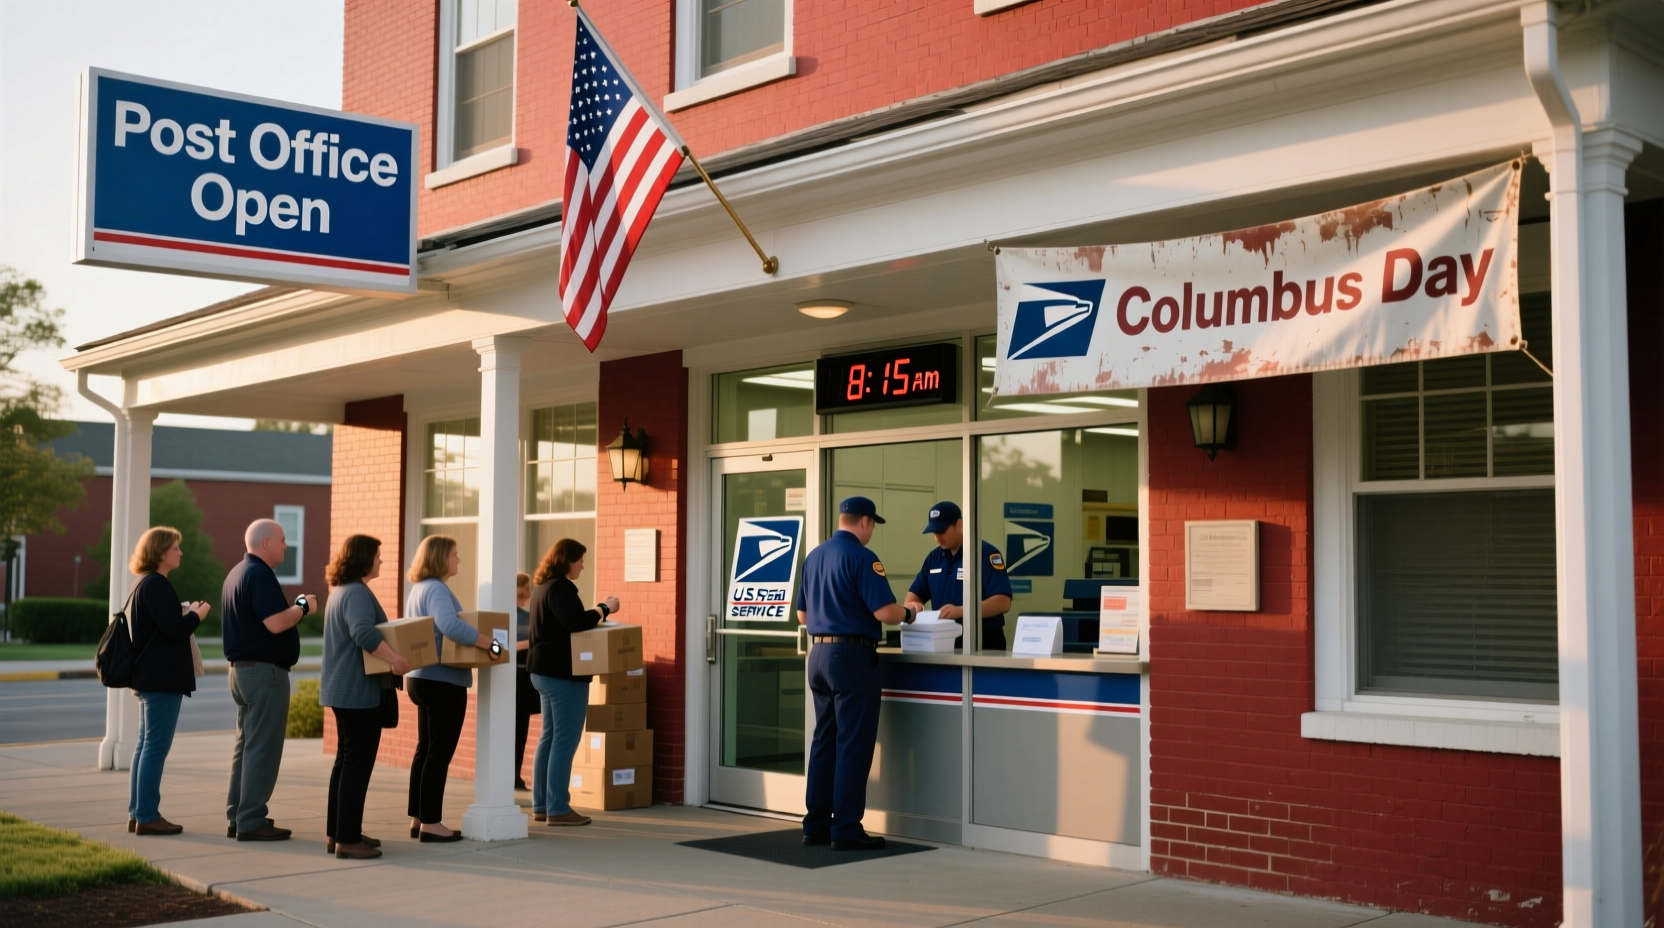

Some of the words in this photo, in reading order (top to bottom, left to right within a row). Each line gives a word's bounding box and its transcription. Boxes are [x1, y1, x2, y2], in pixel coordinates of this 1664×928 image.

[114, 100, 236, 164] Post
[249, 122, 398, 187] Office
[191, 172, 330, 236] Open
[1117, 271, 1363, 336] Columbus
[1381, 247, 1495, 307] Day
[846, 357, 911, 401] 8:15
